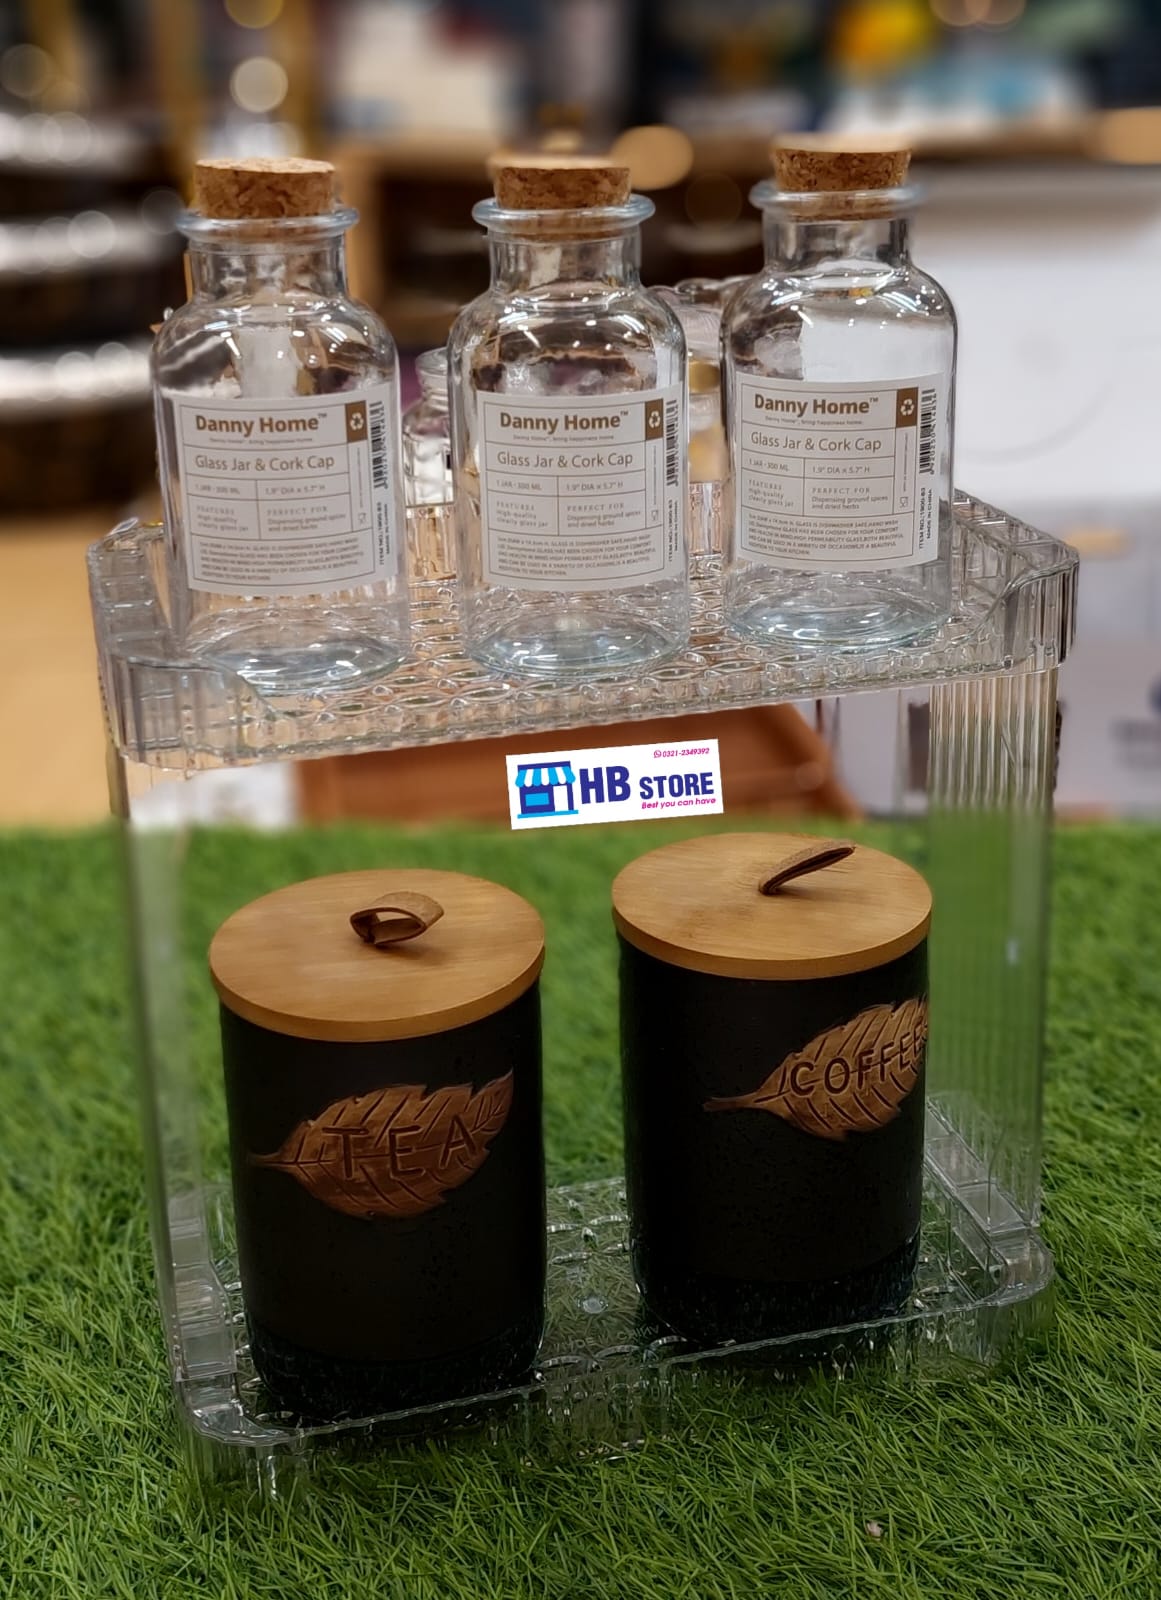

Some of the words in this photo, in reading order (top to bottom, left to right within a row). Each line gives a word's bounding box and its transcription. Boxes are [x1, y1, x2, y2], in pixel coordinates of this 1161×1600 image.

[754, 393, 808, 418] Danny
[195, 415, 254, 437] Danny
[500, 412, 558, 434] Danny
[751, 431, 780, 448] Glass
[783, 435, 801, 450] Jar
[804, 438, 814, 450] &
[819, 438, 851, 451] Cork
[855, 438, 882, 453] Cap
[195, 455, 228, 470] Glass
[231, 457, 250, 471] Jar
[255, 458, 266, 471] &
[269, 456, 304, 471] Cork
[307, 455, 335, 470] Cap
[497, 451, 530, 467] Glass
[534, 455, 554, 468] Jar
[557, 455, 568, 468] &
[572, 453, 604, 468] Cork
[608, 452, 633, 468] Cap
[322, 1113, 477, 1180] TEA
